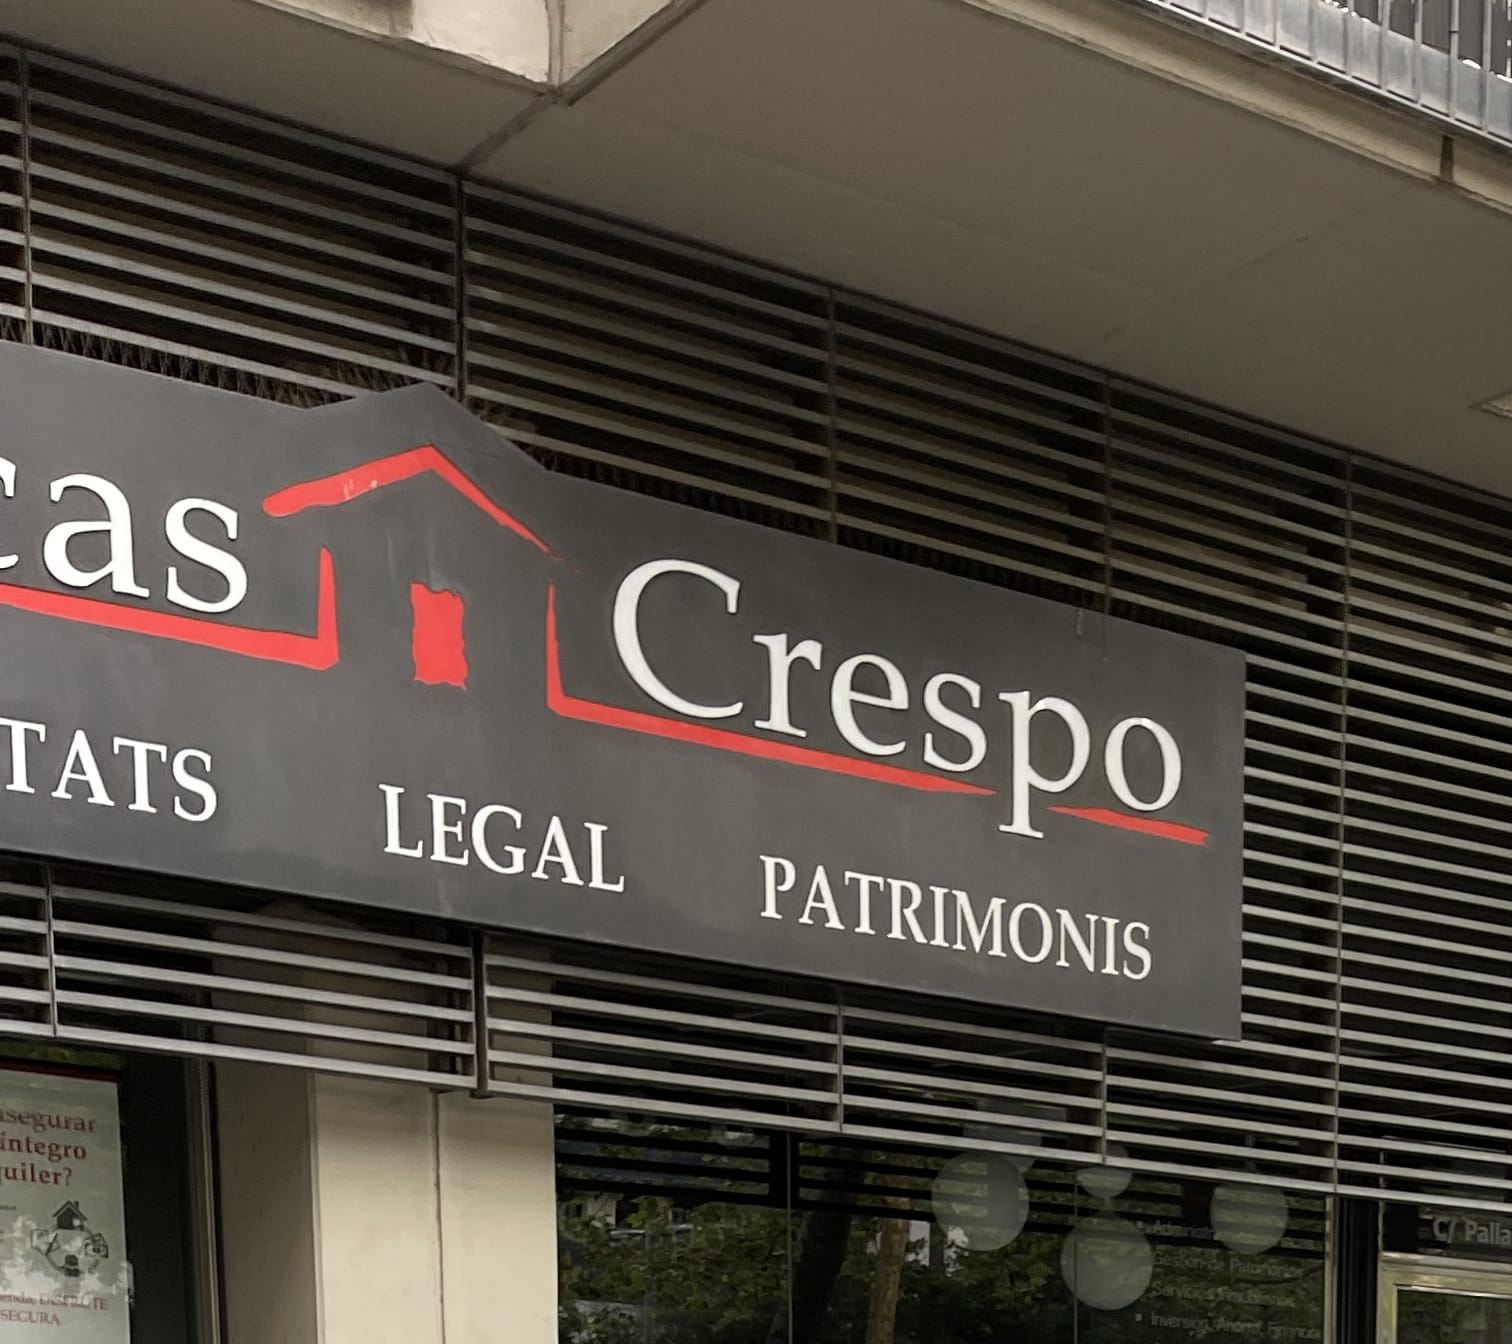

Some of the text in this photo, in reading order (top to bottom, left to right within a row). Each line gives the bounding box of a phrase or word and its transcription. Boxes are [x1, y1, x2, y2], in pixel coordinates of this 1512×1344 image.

[0, 455, 1182, 838] as Crespo
[379, 783, 625, 893] LEGAL
[759, 854, 1153, 981] PATRIMONIS
[0, 1109, 96, 1134] segurar
[0, 1163, 72, 1187] uiler?
[1433, 1216, 1456, 1244] C/
